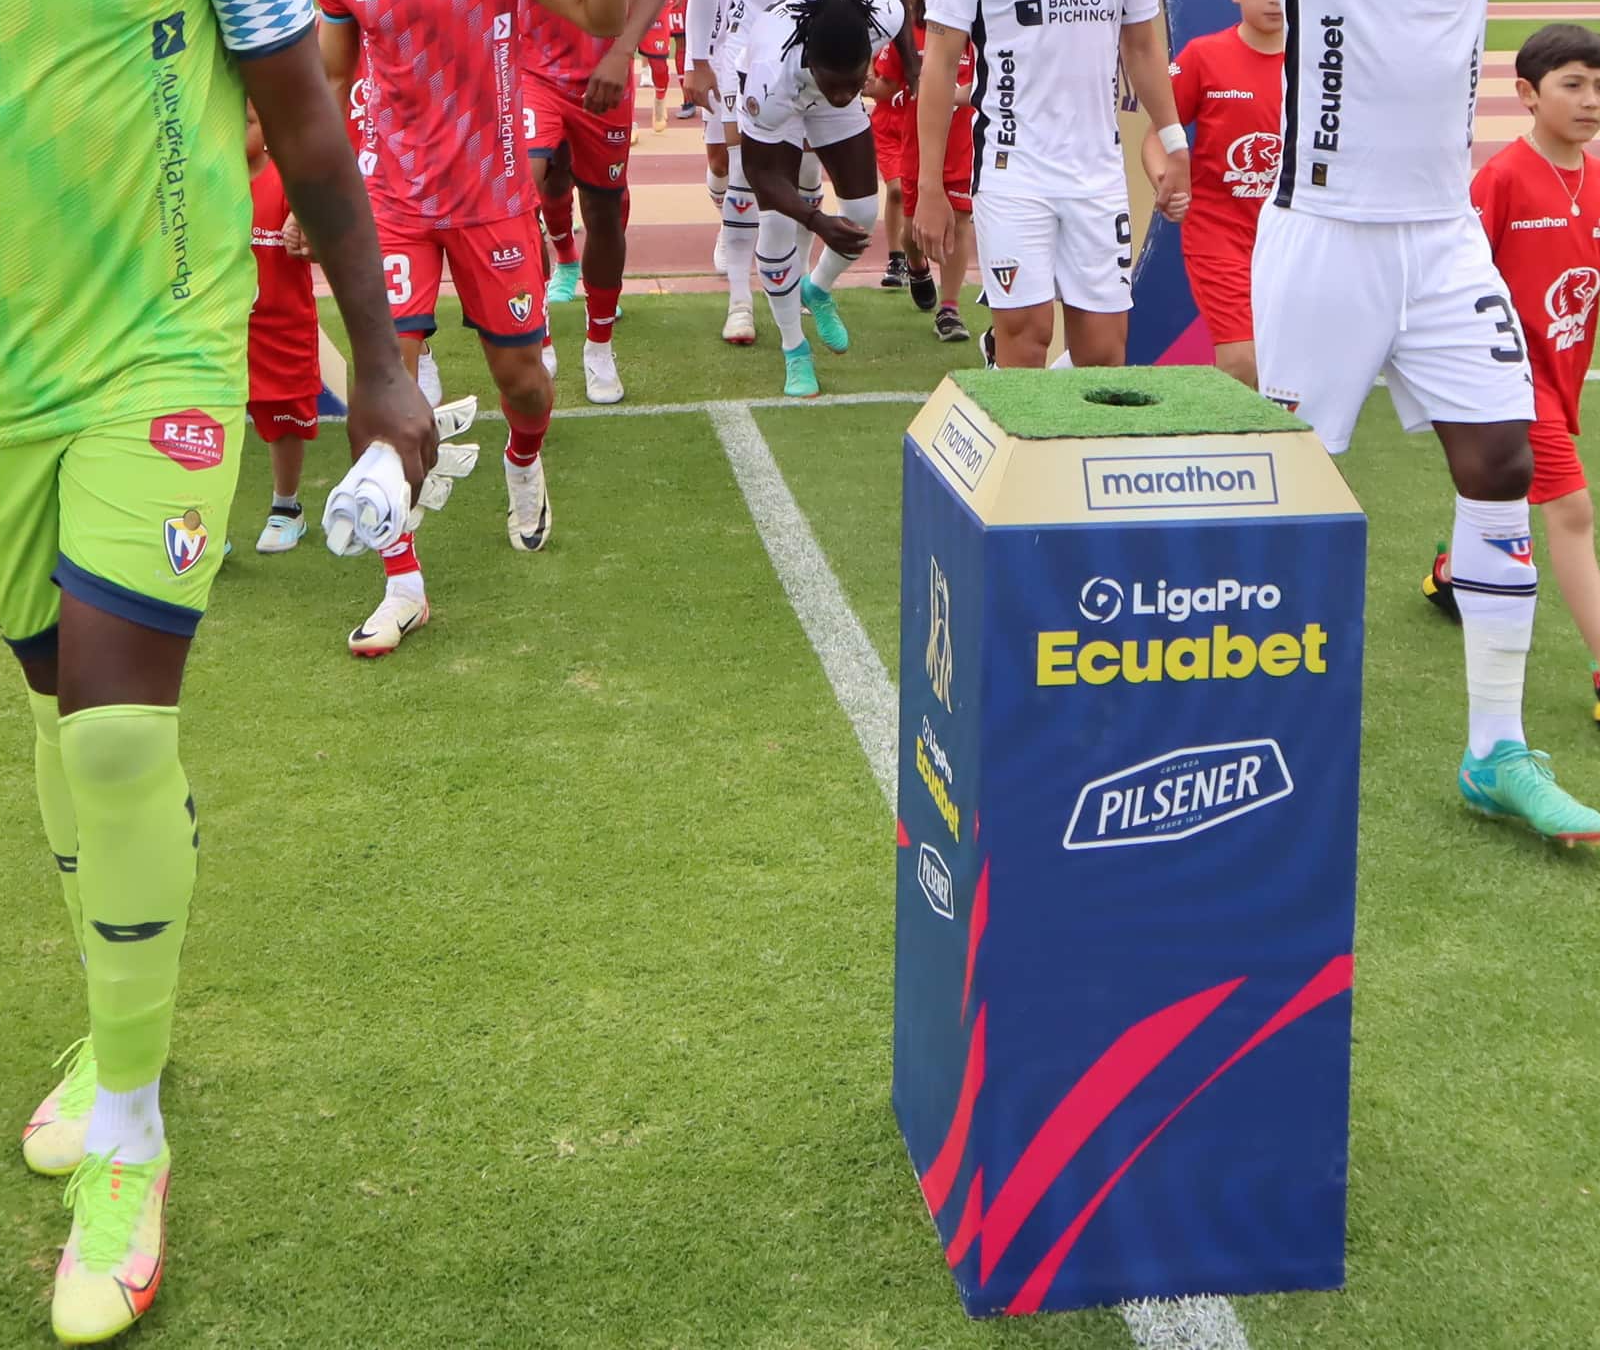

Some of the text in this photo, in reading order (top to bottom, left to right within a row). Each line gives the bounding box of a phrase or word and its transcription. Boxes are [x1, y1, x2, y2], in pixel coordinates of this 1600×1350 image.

[669, 13, 684, 29] 14
[1049, 9, 1118, 24] PICHINCH
[996, 49, 1017, 146] Ecuabet
[1206, 89, 1254, 99] marathon
[1313, 15, 1344, 152] Ecuabet
[501, 113, 515, 178] Pichincha
[1511, 216, 1568, 230] marathon
[383, 254, 412, 304] 3
[1474, 295, 1524, 364] 3
[163, 422, 218, 449] R.E.S.
[940, 420, 983, 475] marathon
[1102, 465, 1256, 495] marathon
[1132, 579, 1281, 622] LigaPro
[1036, 623, 1327, 687] Ecuabet
[928, 728, 953, 785] LigaPro
[916, 735, 960, 843] Ecuabet
[1096, 754, 1262, 836] PILSENER
[922, 854, 950, 910] PILSENER
